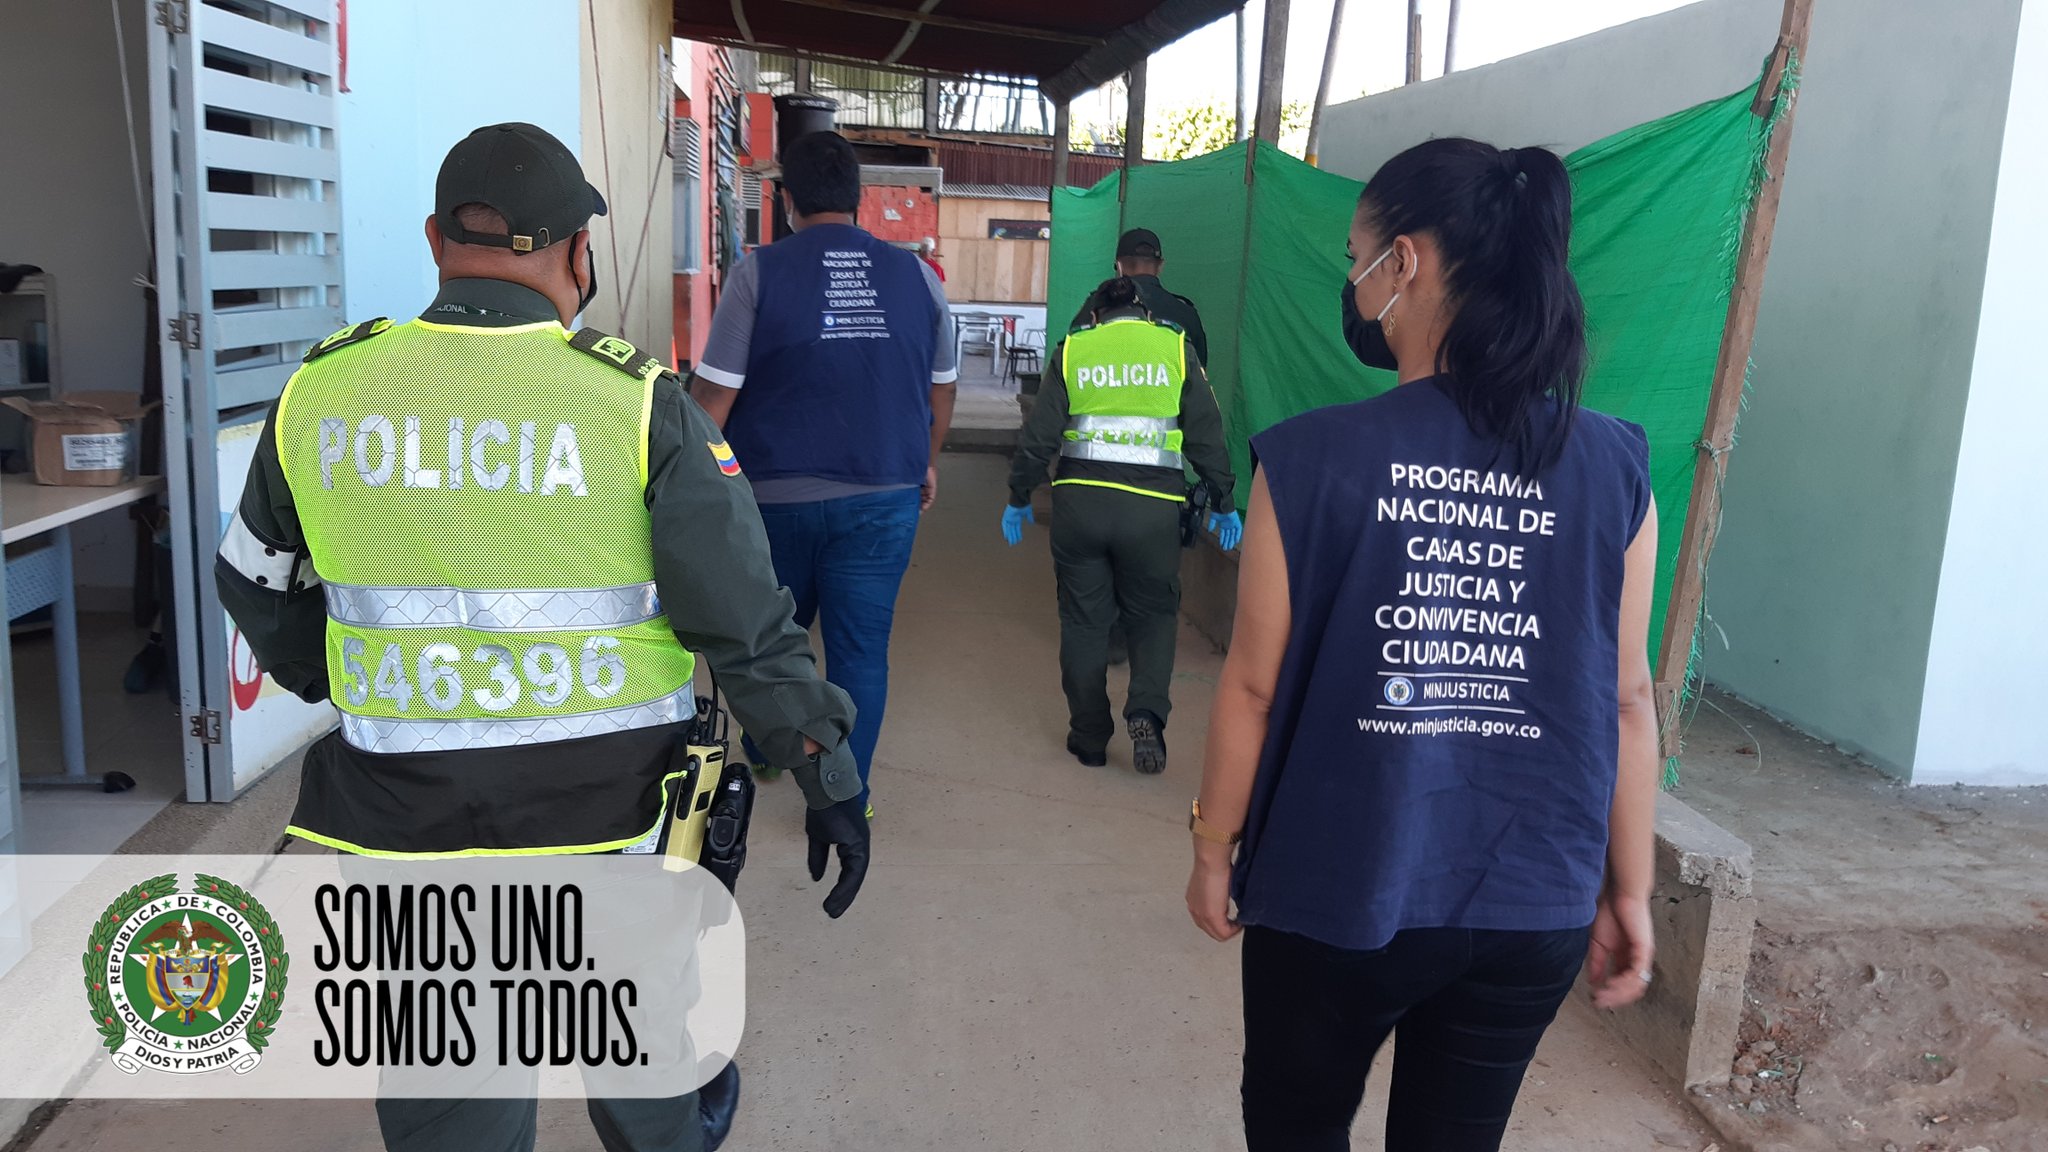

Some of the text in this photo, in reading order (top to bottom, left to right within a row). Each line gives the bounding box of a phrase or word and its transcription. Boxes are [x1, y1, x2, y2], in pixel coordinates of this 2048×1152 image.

[830, 271, 855, 279] CASAS
[825, 290, 878, 298] CONVIVENCIA
[829, 299, 876, 307] CIUDADANA
[1077, 363, 1170, 390] POLICIA
[319, 414, 589, 497] POLICIA
[1390, 463, 1543, 501] PROGRAMA
[1377, 498, 1557, 537] NACIONAL DE
[1406, 536, 1524, 570] CASAS DE
[1397, 571, 1527, 604] JUSTICIA Y
[1374, 604, 1541, 639] CONVIVENCIA
[1382, 639, 1525, 670] CIUDADANA
[341, 635, 627, 712] 546396
[1422, 682, 1510, 703] MINJUSTICIA
[1357, 715, 1541, 740] www.minjusticia.gov.co
